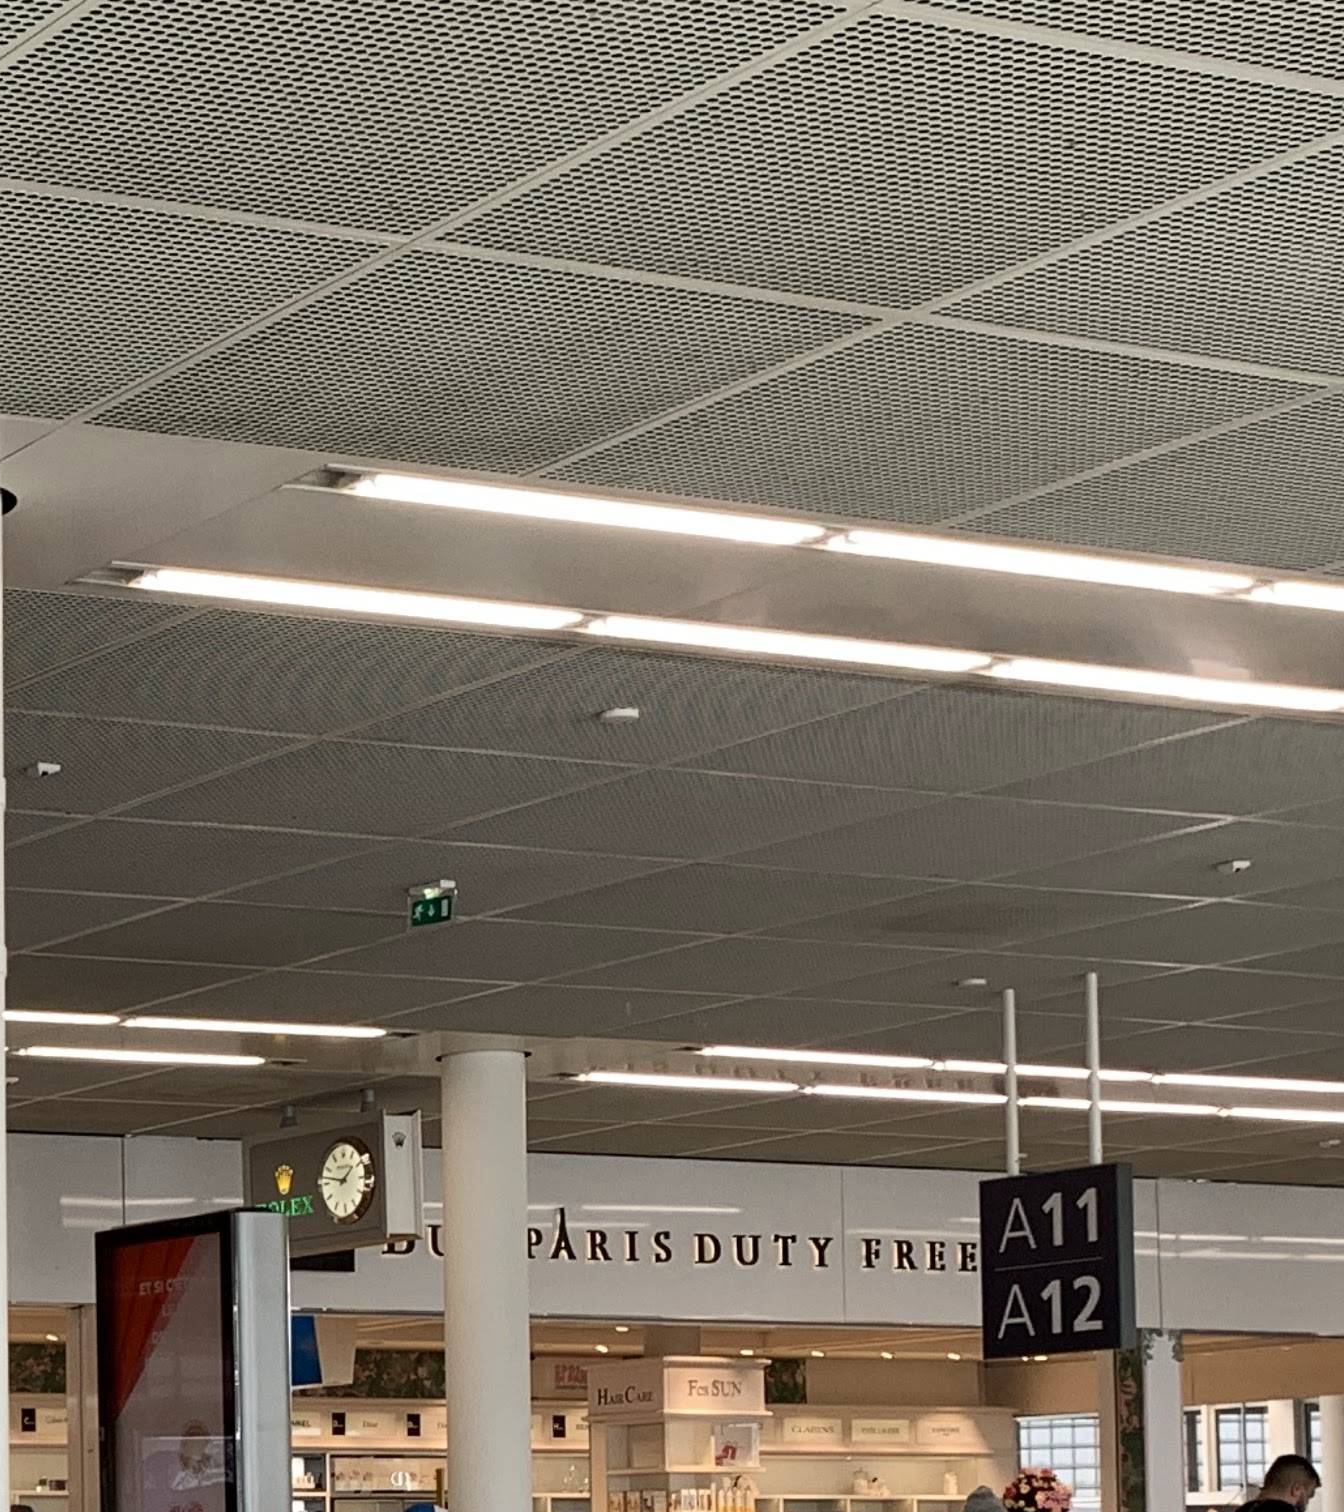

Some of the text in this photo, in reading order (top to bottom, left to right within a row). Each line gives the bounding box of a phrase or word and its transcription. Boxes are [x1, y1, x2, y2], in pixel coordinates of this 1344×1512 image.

[527, 1207, 978, 1272] PARIS DUTY FREE
[999, 1187, 1098, 1254] A11
[998, 1275, 1103, 1339] A12
[711, 1380, 742, 1397] SUN
